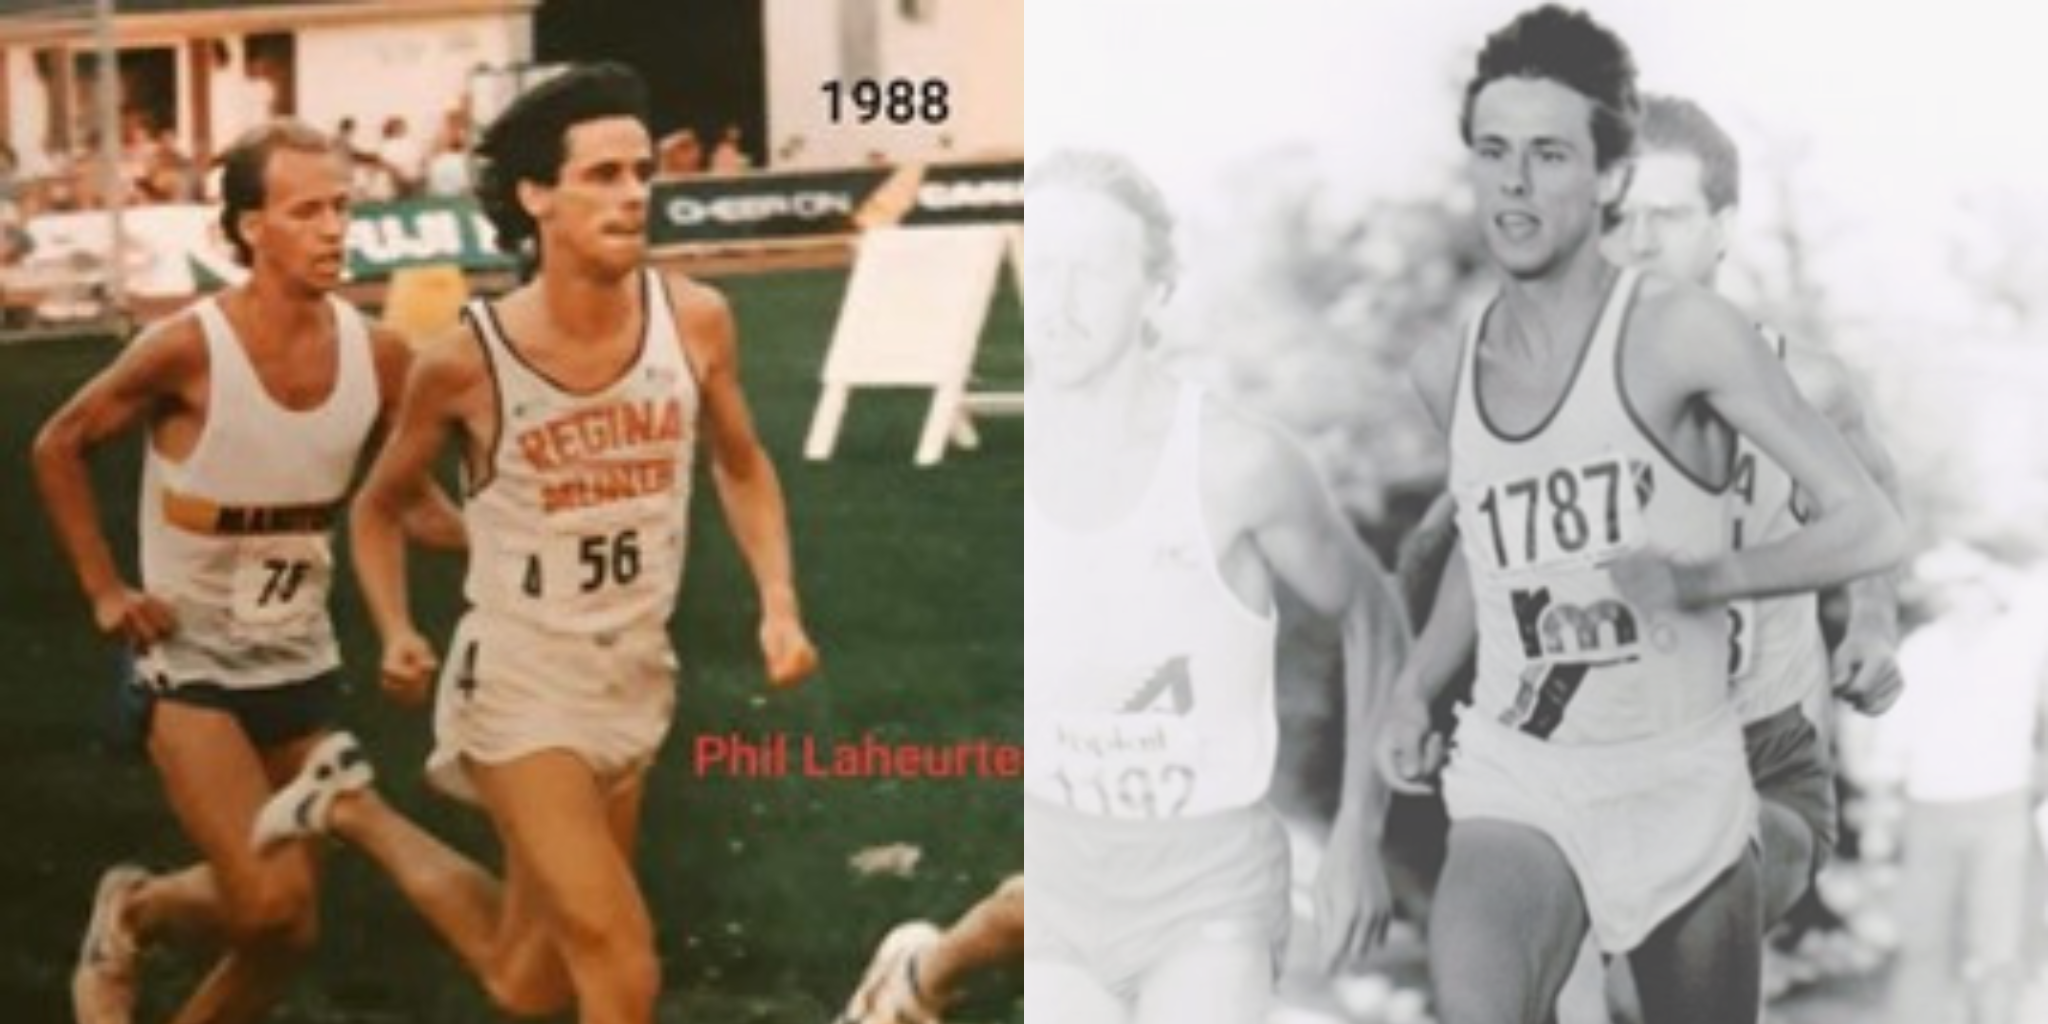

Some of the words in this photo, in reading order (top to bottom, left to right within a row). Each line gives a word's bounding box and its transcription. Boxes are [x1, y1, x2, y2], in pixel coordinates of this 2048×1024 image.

[517, 400, 682, 472] REGINA
[1478, 460, 1620, 568] 1787
[579, 530, 641, 594] 56
